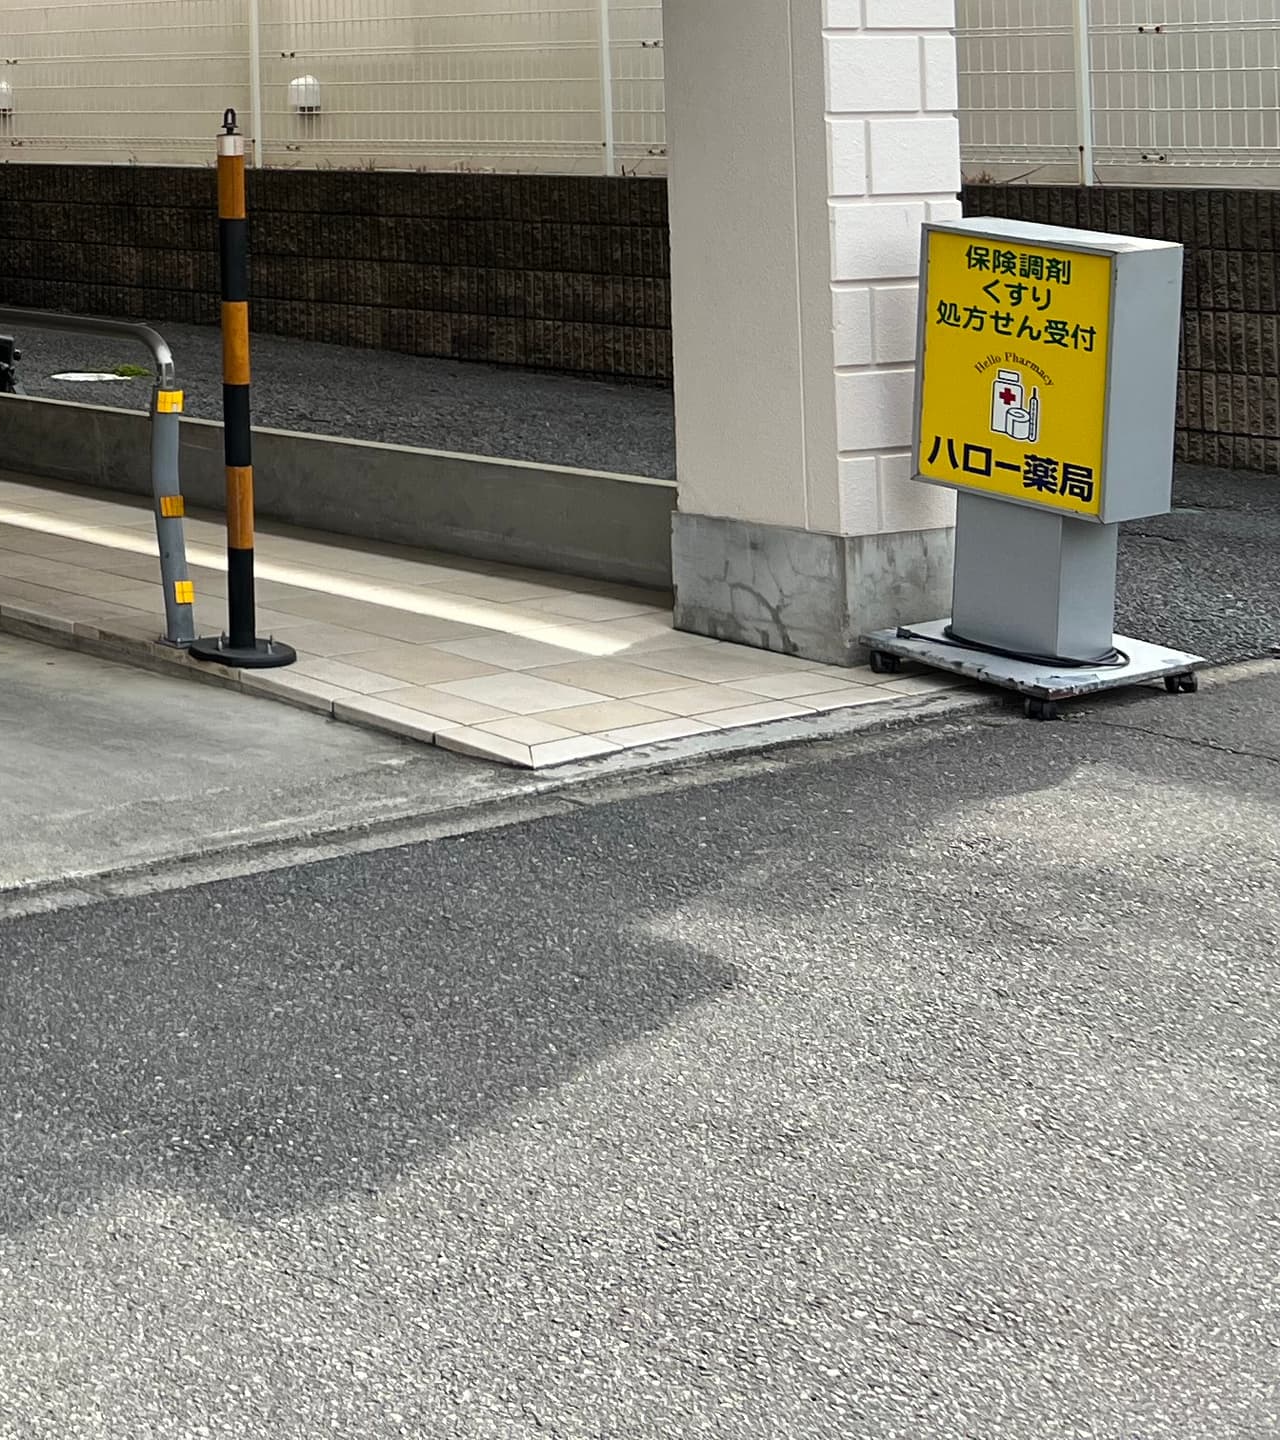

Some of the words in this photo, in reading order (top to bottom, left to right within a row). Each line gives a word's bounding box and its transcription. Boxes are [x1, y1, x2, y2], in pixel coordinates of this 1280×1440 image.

[964, 244, 1072, 286] 保険調剤
[982, 279, 1052, 311] くすり
[935, 299, 1097, 353] 処方せん受付
[973, 354, 1002, 375] Hello
[1004, 351, 1055, 388] Pharmacy
[927, 435, 1095, 503] ハロー薬局
